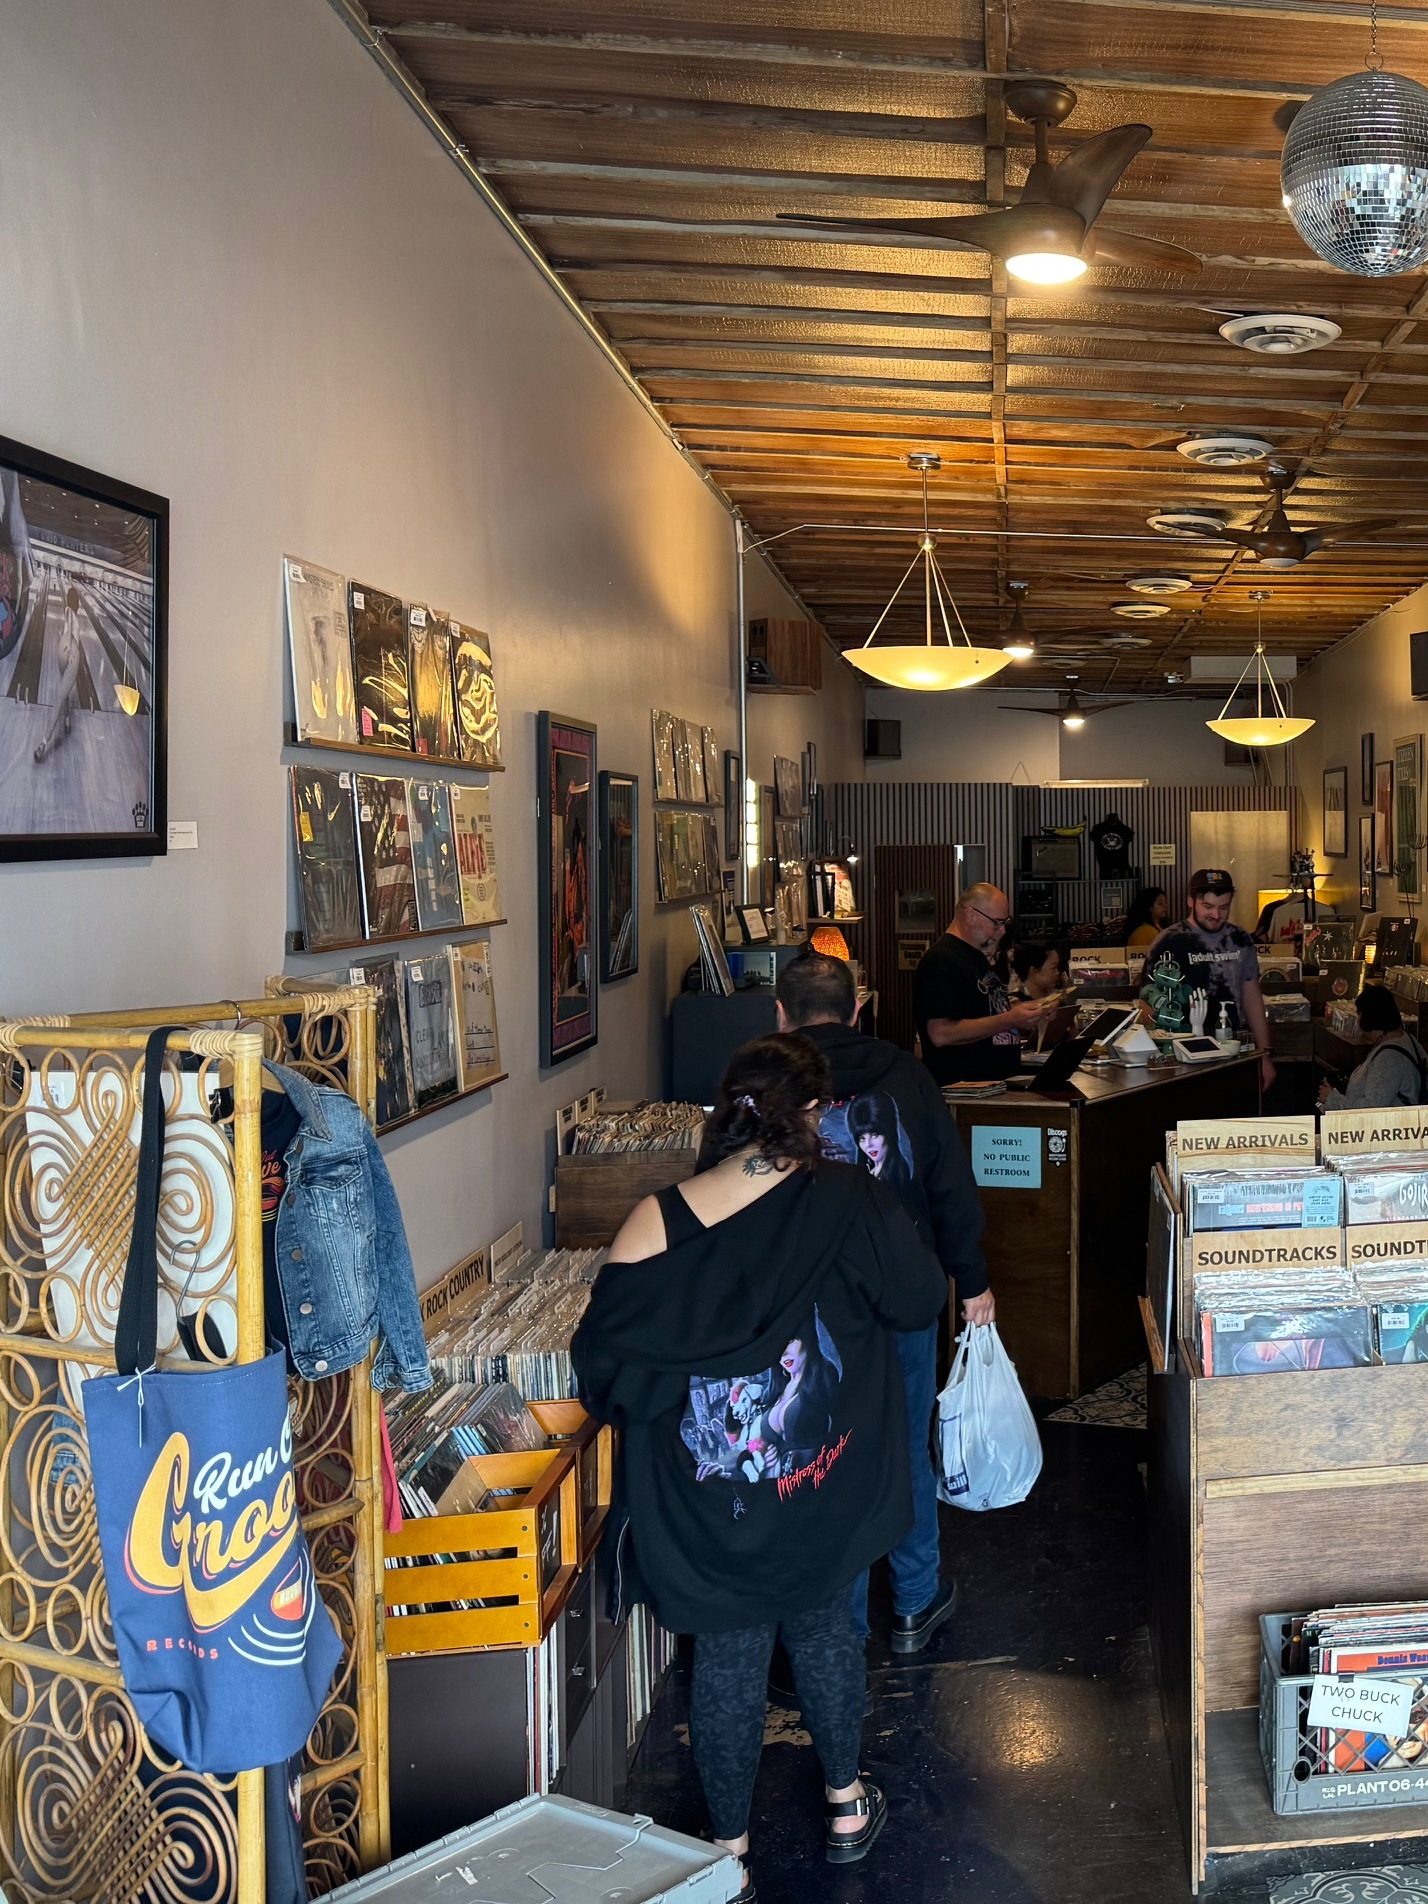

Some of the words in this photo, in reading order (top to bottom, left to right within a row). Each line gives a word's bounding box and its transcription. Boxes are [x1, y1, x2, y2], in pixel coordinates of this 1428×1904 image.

[991, 1138, 1022, 1147] SORRY!
[1182, 1136, 1221, 1151] NEW
[1225, 1133, 1309, 1149] ARRIVALS
[1328, 1130, 1365, 1145] NEW
[983, 1153, 996, 1161] NO
[999, 1153, 1030, 1162] PUBLIC
[984, 1168, 1030, 1177] RESTROOM
[1197, 1245, 1337, 1266] SOUNDTRACKS
[449, 1254, 485, 1300] COUNTRY
[426, 1285, 449, 1320] ROCK
[193, 1446, 278, 1514] Run
[1377, 1654, 1408, 1665] Dennis
[1320, 1685, 1357, 1699] TWO
[1360, 1689, 1401, 1705] BUCK
[1332, 1706, 1383, 1723] CHUCK
[1337, 1780, 1388, 1797] PLANT
